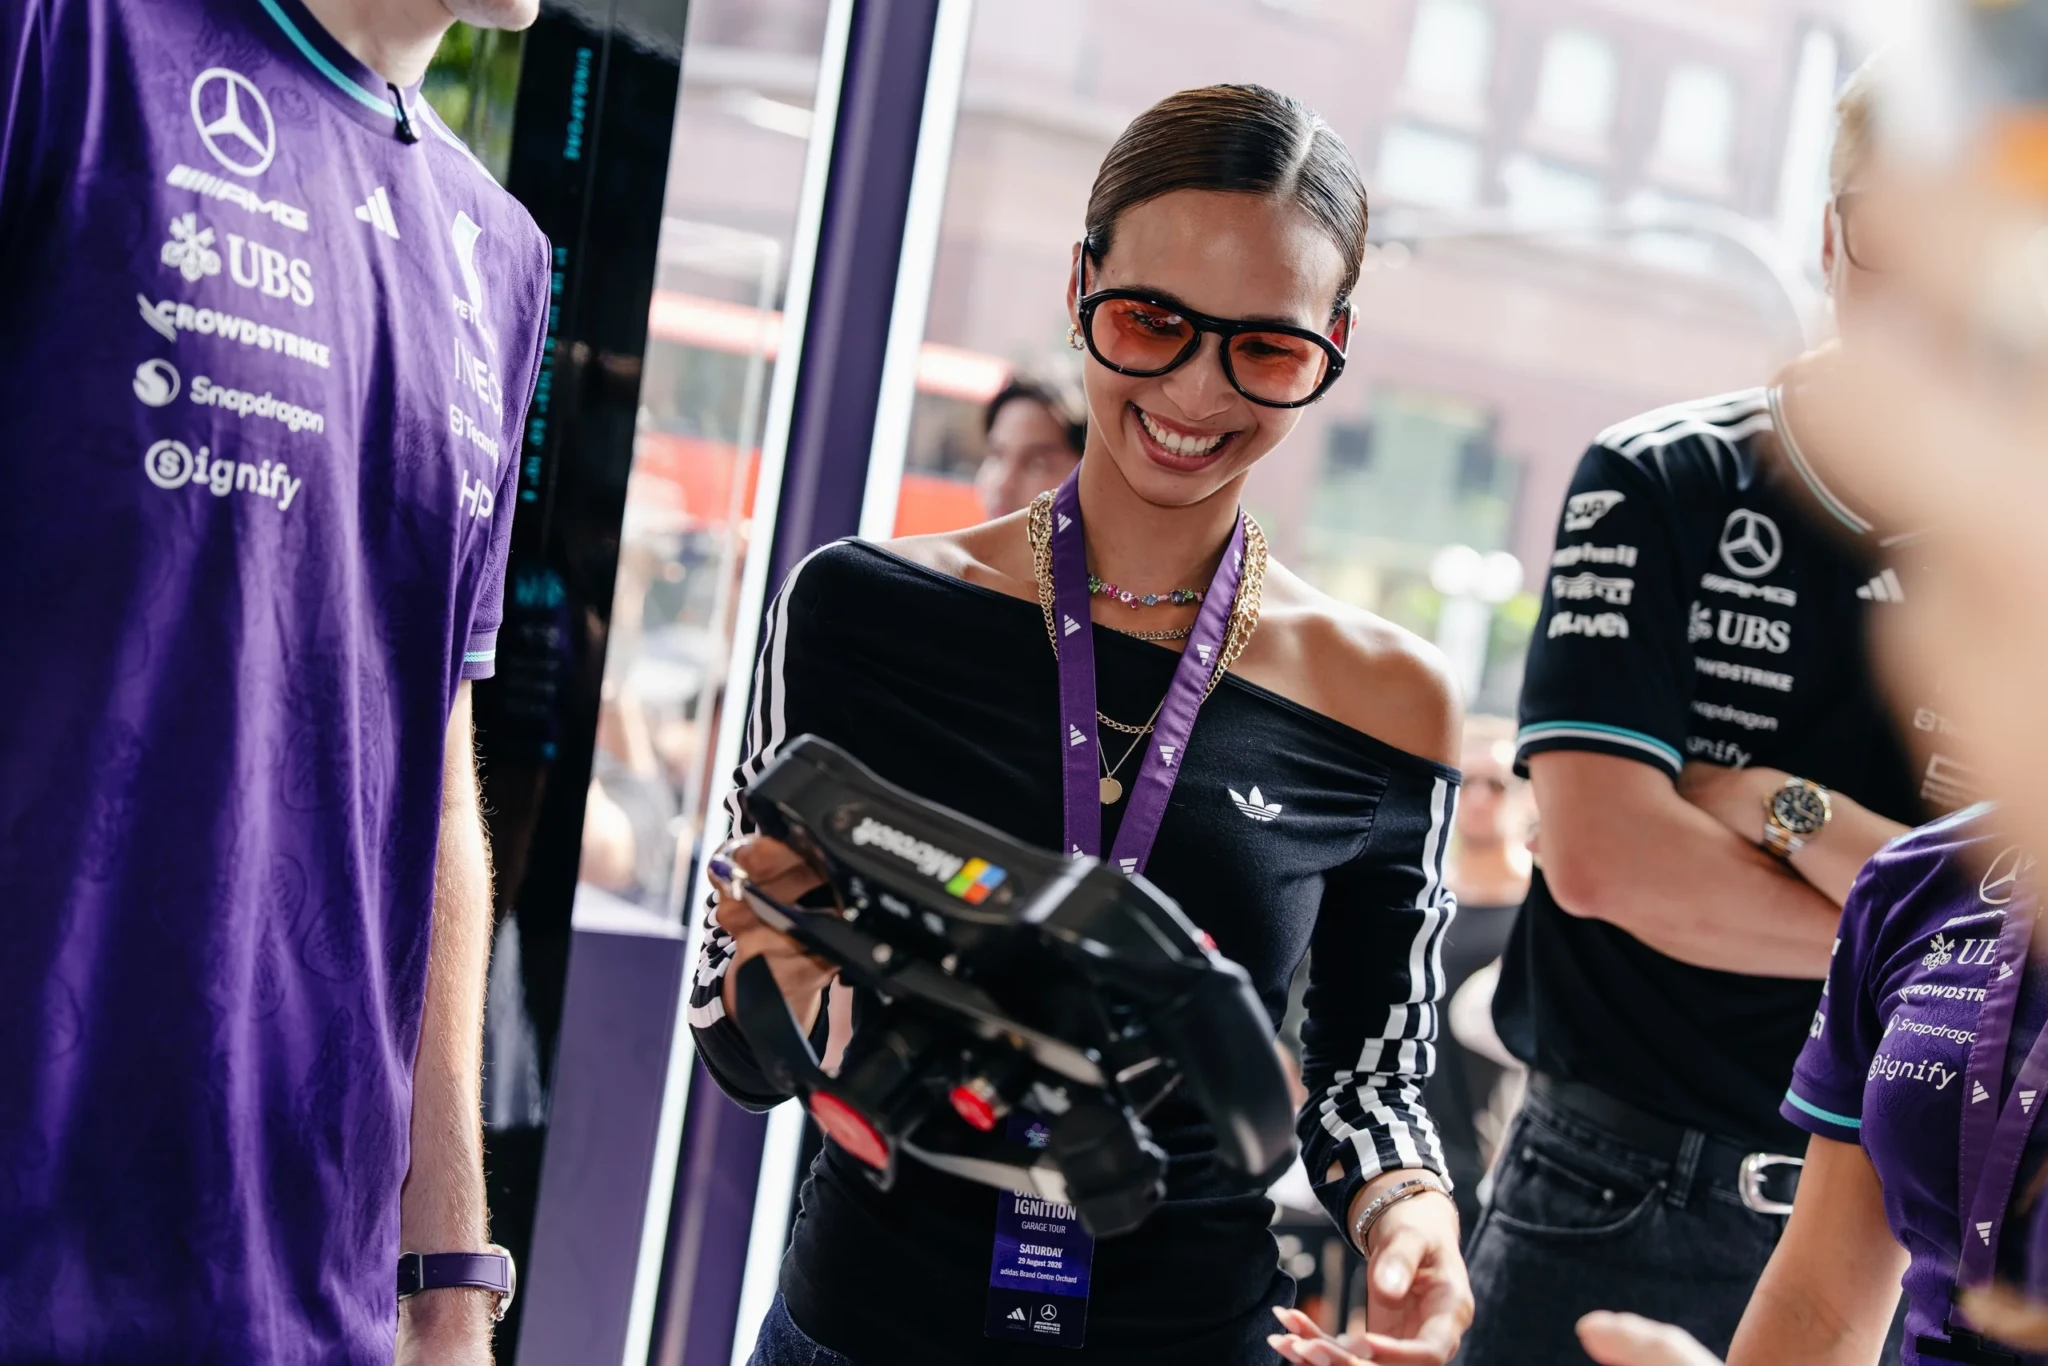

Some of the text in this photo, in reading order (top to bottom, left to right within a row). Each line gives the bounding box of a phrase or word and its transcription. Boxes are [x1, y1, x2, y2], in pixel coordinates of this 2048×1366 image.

[226, 233, 314, 307] UBS
[155, 299, 330, 368] CROWDSTRIKE
[454, 336, 503, 428] INEO
[190, 375, 324, 434] Snapdragon
[145, 439, 301, 511] Signify
[1717, 609, 1791, 654] UBS
[1686, 736, 1752, 769] gnify
[1904, 984, 1987, 1002] CROWDSTR
[1898, 1018, 1976, 1044] Snapdrago
[1868, 1054, 1957, 1090] Signify
[1014, 1198, 1077, 1221] IGNITION
[1021, 1220, 1066, 1234] GARAGE TOUR
[1017, 1257, 1026, 1265] 29
[1026, 1258, 1046, 1268] August
[1019, 1243, 1063, 1258] SATURDAY
[1000, 1268, 1019, 1277] adidas
[1019, 1269, 1036, 1279] Brand
[1055, 1274, 1077, 1284] Orchard
